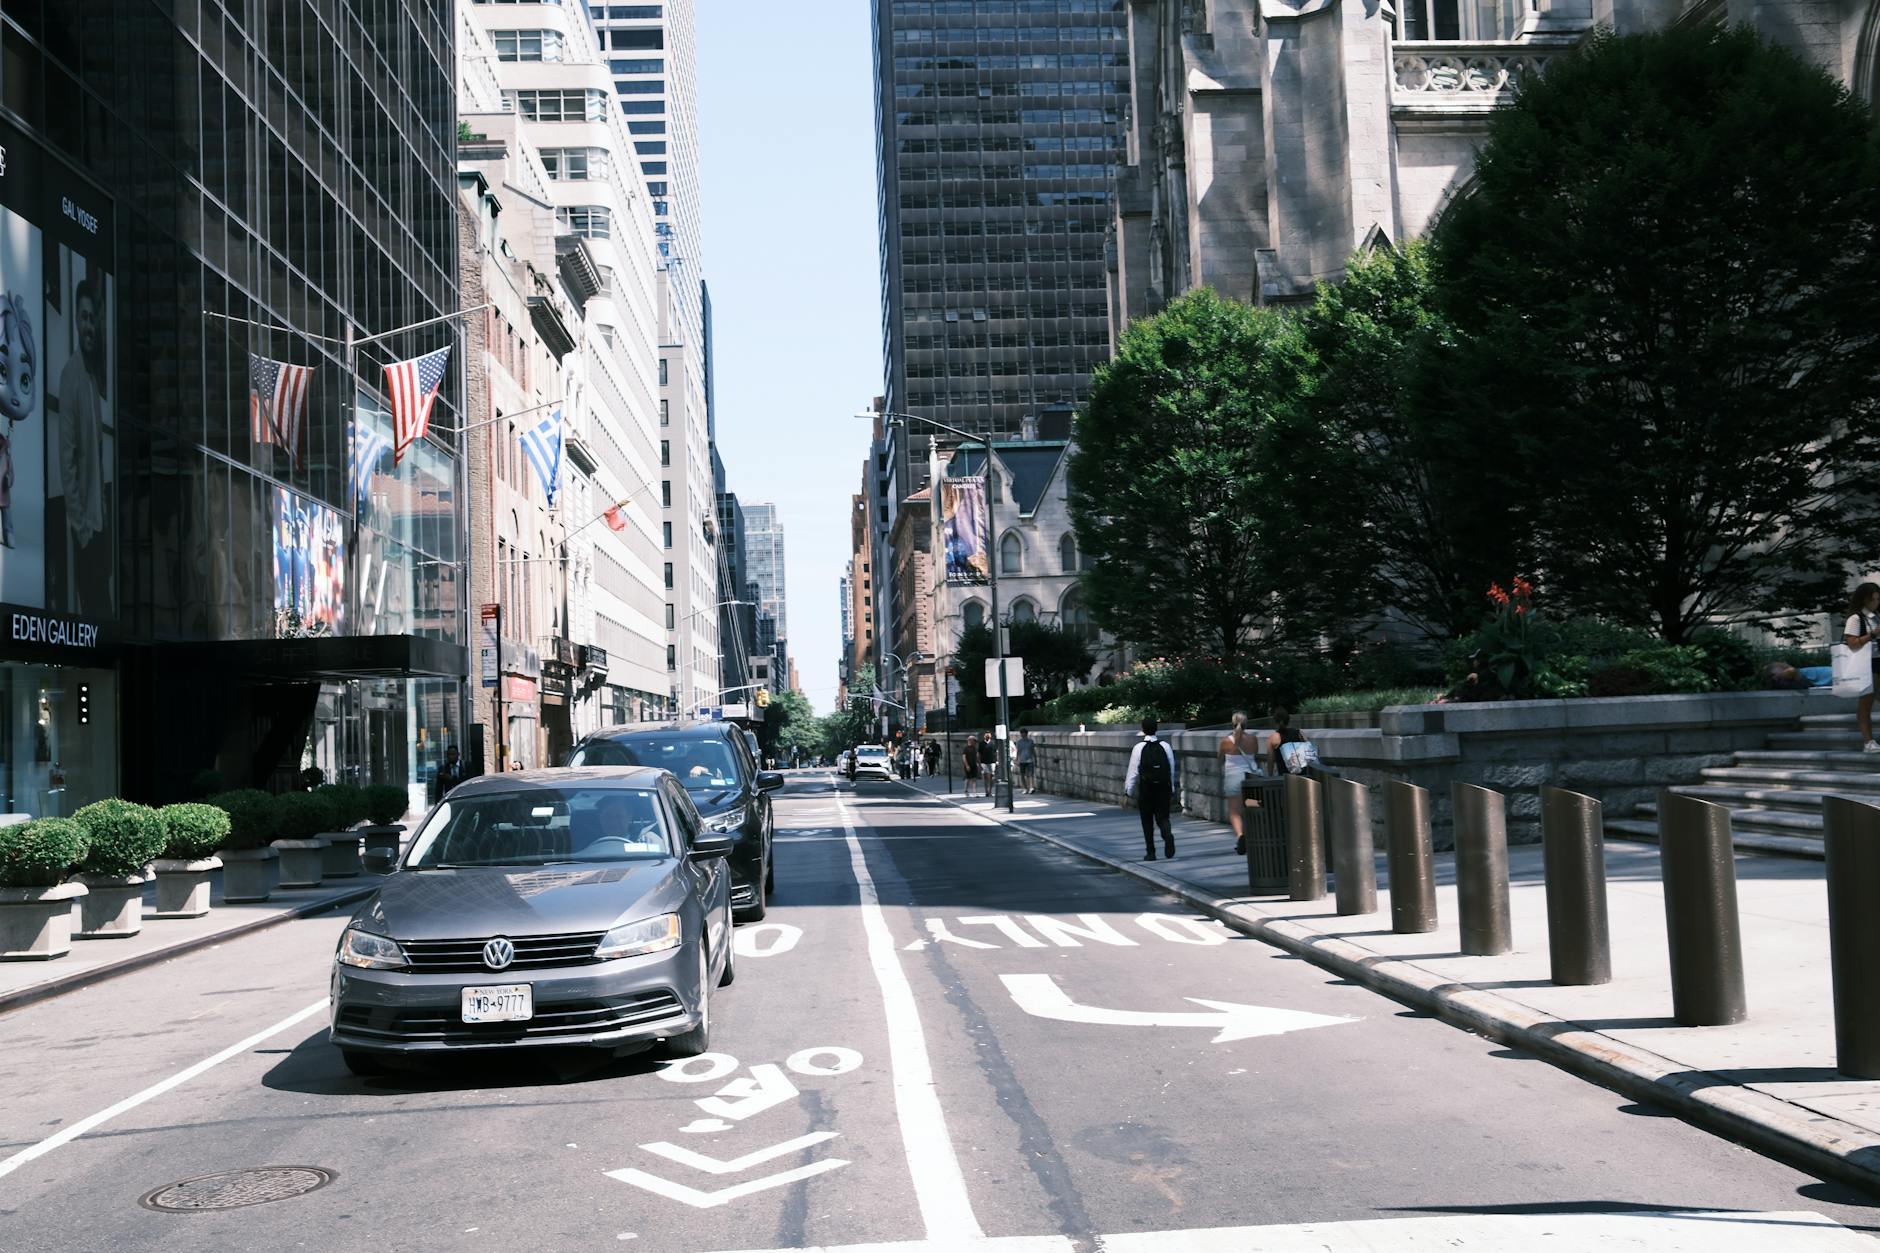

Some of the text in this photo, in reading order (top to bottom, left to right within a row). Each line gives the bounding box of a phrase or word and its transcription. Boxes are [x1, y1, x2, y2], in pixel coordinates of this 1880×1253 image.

[62, 196, 98, 234] GAL YOSEF
[13, 614, 98, 648] EDEN GALLERY
[904, 913, 1228, 950] ONLY
